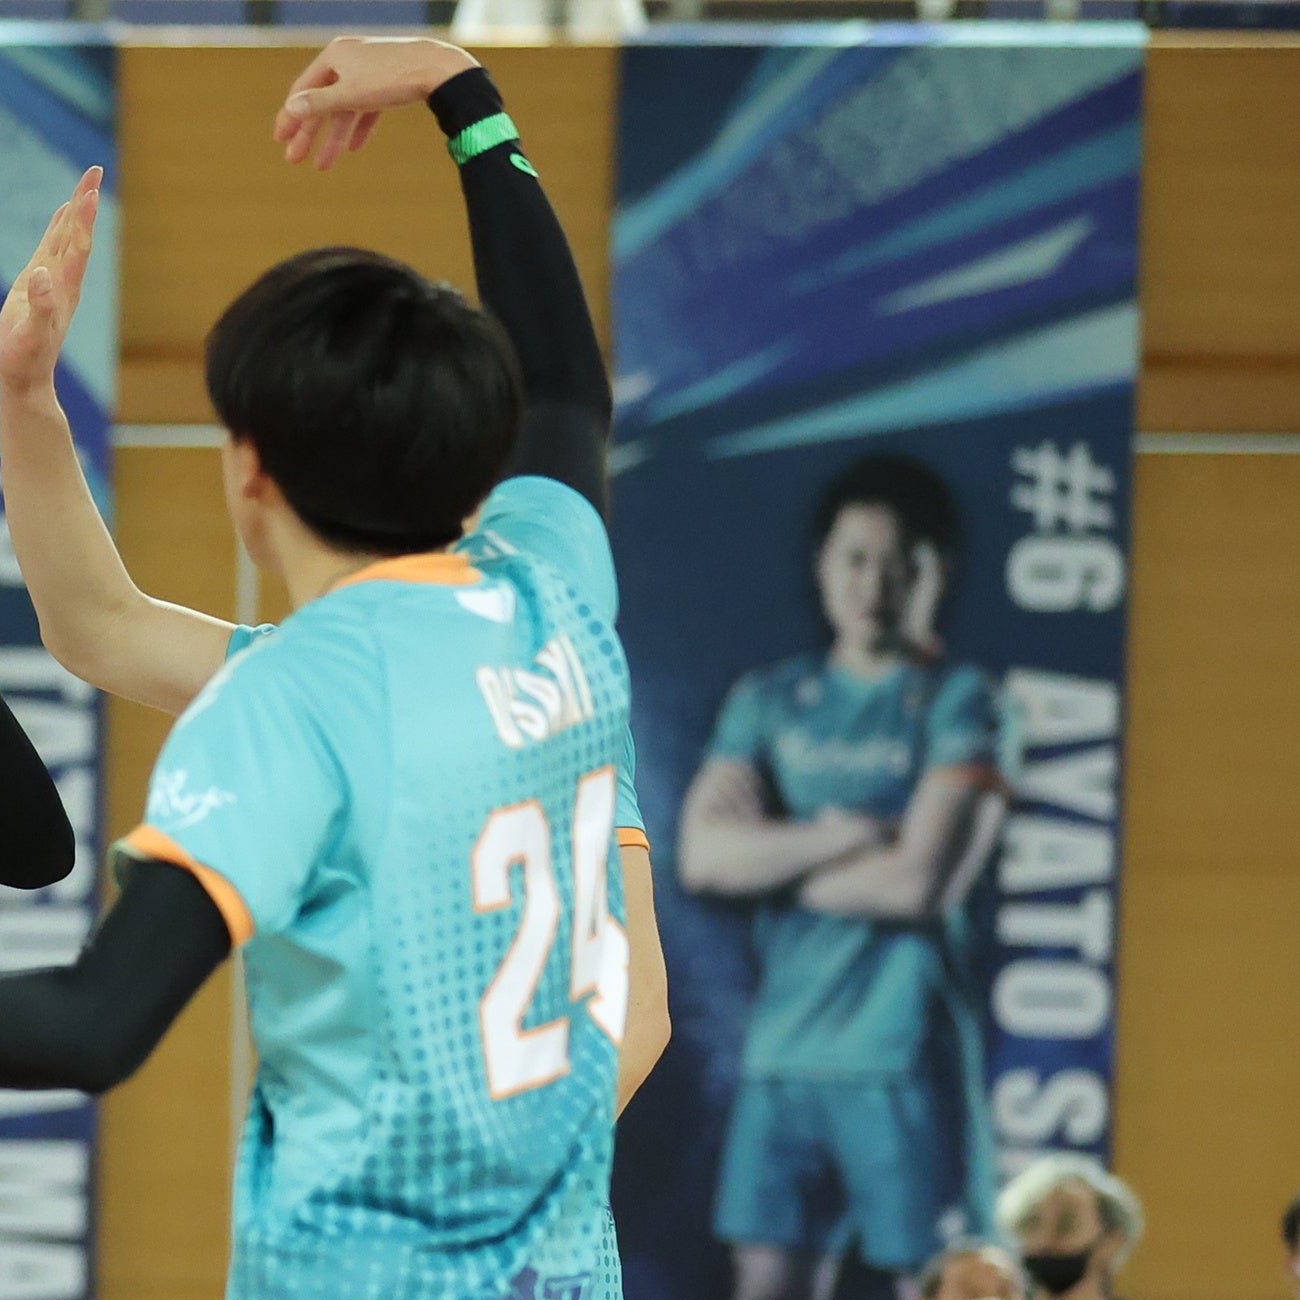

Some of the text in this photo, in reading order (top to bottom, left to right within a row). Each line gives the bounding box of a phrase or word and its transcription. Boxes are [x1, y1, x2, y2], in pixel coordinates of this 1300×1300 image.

[1008, 438, 1126, 613] #6
[471, 764, 629, 1101] 24
[992, 667, 1121, 1041] AYATO
